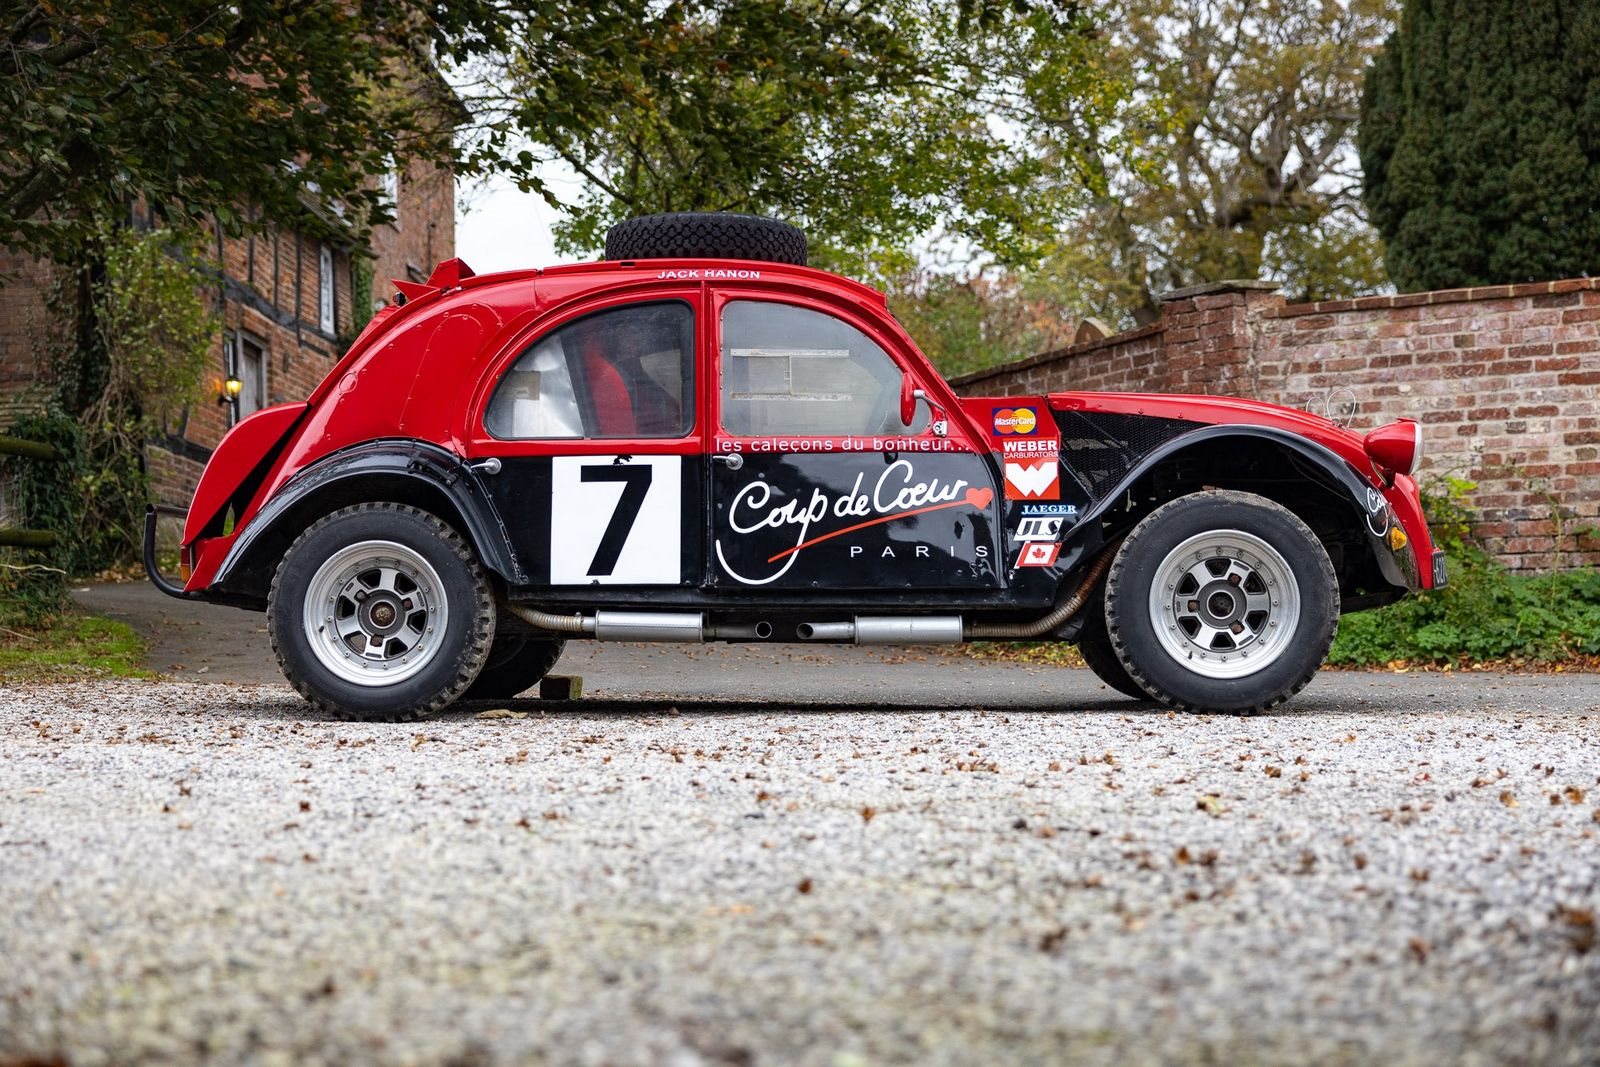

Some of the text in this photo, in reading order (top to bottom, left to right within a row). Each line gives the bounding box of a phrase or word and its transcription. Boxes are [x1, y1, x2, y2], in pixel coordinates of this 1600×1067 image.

[657, 269, 760, 279] JACK HANON
[994, 417, 1035, 426] MasterCard
[716, 436, 970, 453] les caleçons du bonheur...
[1003, 440, 1058, 452] WEBER
[1003, 451, 1059, 459] CARBURATORS
[1021, 505, 1077, 514] JAEGER
[580, 464, 653, 577] 7
[716, 480, 828, 585] Coup
[833, 472, 871, 517] de
[850, 545, 988, 558] PARIS
